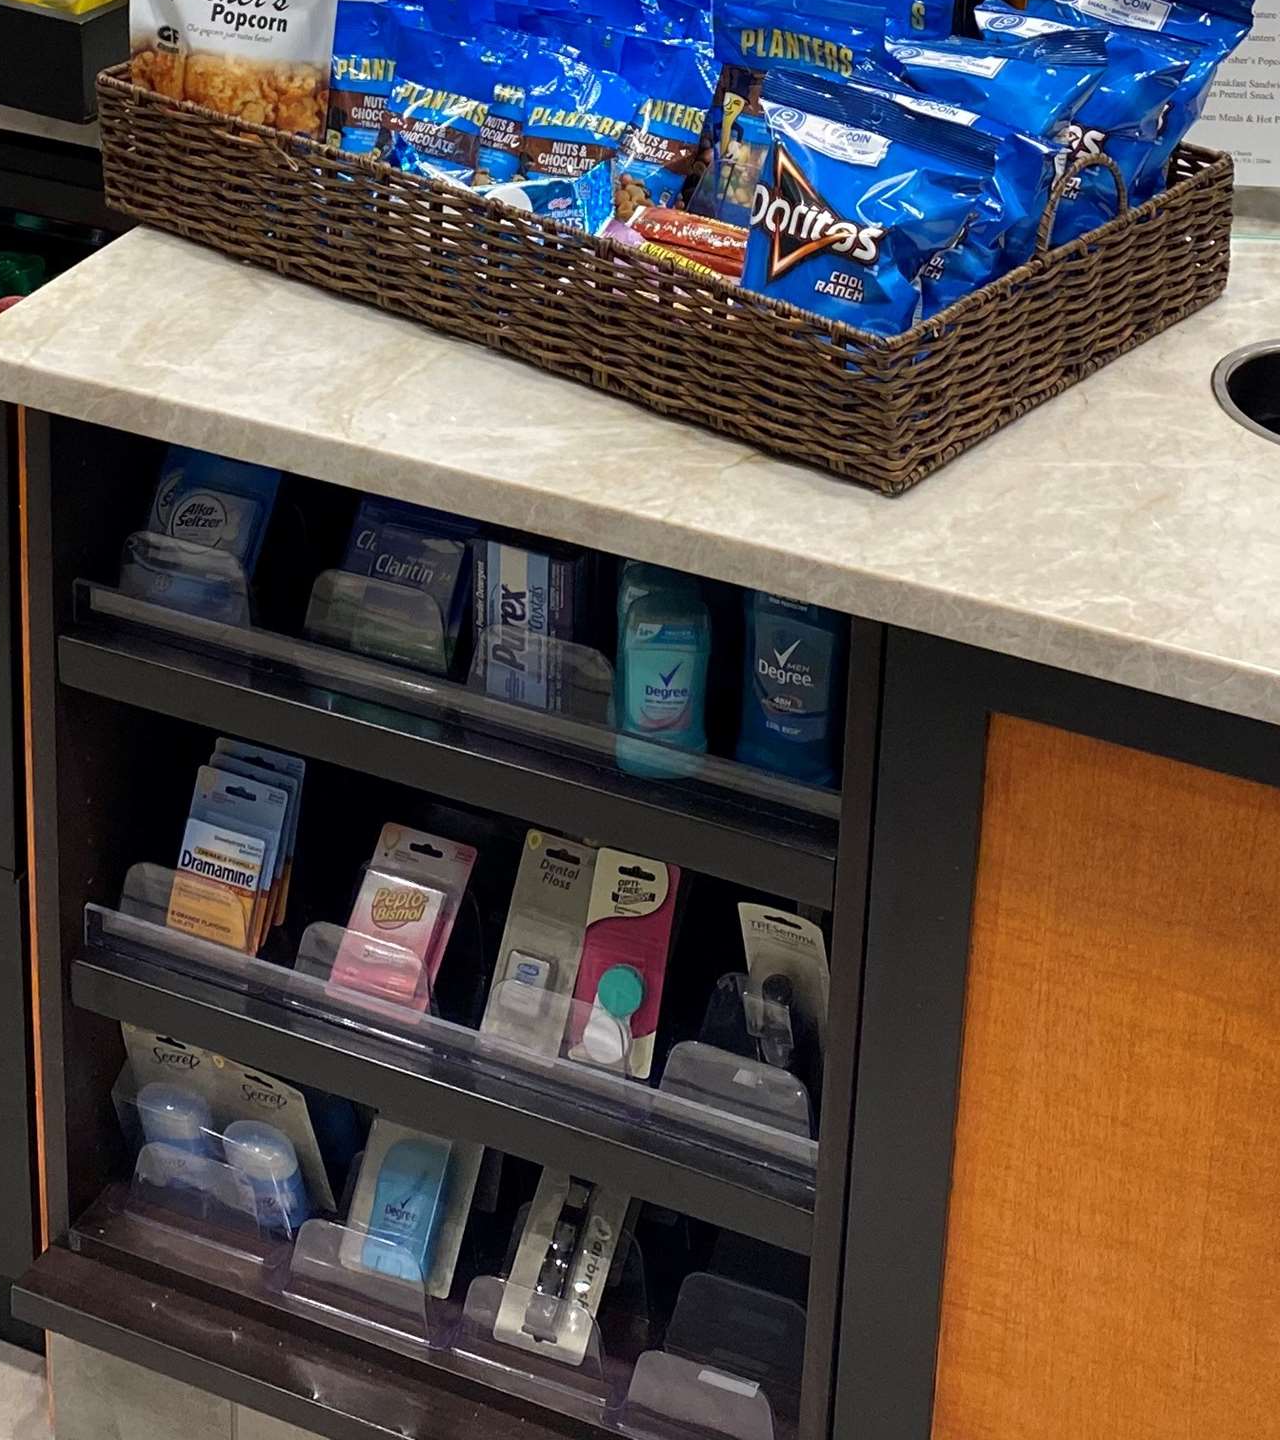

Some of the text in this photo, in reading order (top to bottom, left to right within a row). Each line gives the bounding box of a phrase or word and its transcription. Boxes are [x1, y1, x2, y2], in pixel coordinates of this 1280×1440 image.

[211, 3, 287, 32] Popcorn
[740, 27, 853, 78] PLANTERS
[397, 84, 488, 127] PLANTERS
[529, 107, 626, 136] PLANTERS
[552, 142, 577, 156] NUTS
[538, 153, 595, 171] CHOCOLATE
[751, 184, 883, 261] Doritos
[815, 280, 864, 302] RANCH
[830, 271, 864, 290] COOL
[186, 503, 218, 517] Alka-
[176, 514, 223, 529] Seltzer
[376, 553, 434, 584] Claritin
[758, 658, 812, 687] Degree
[645, 684, 688, 700] Degree
[180, 850, 255, 889] Dramamine
[540, 860, 579, 880] Dental
[543, 872, 572, 890] Floss
[618, 880, 640, 888] OPTI-
[372, 887, 427, 910] Pepto-
[375, 904, 427, 923] Bismol
[152, 1046, 200, 1070] Secret
[241, 1084, 288, 1109] Secret
